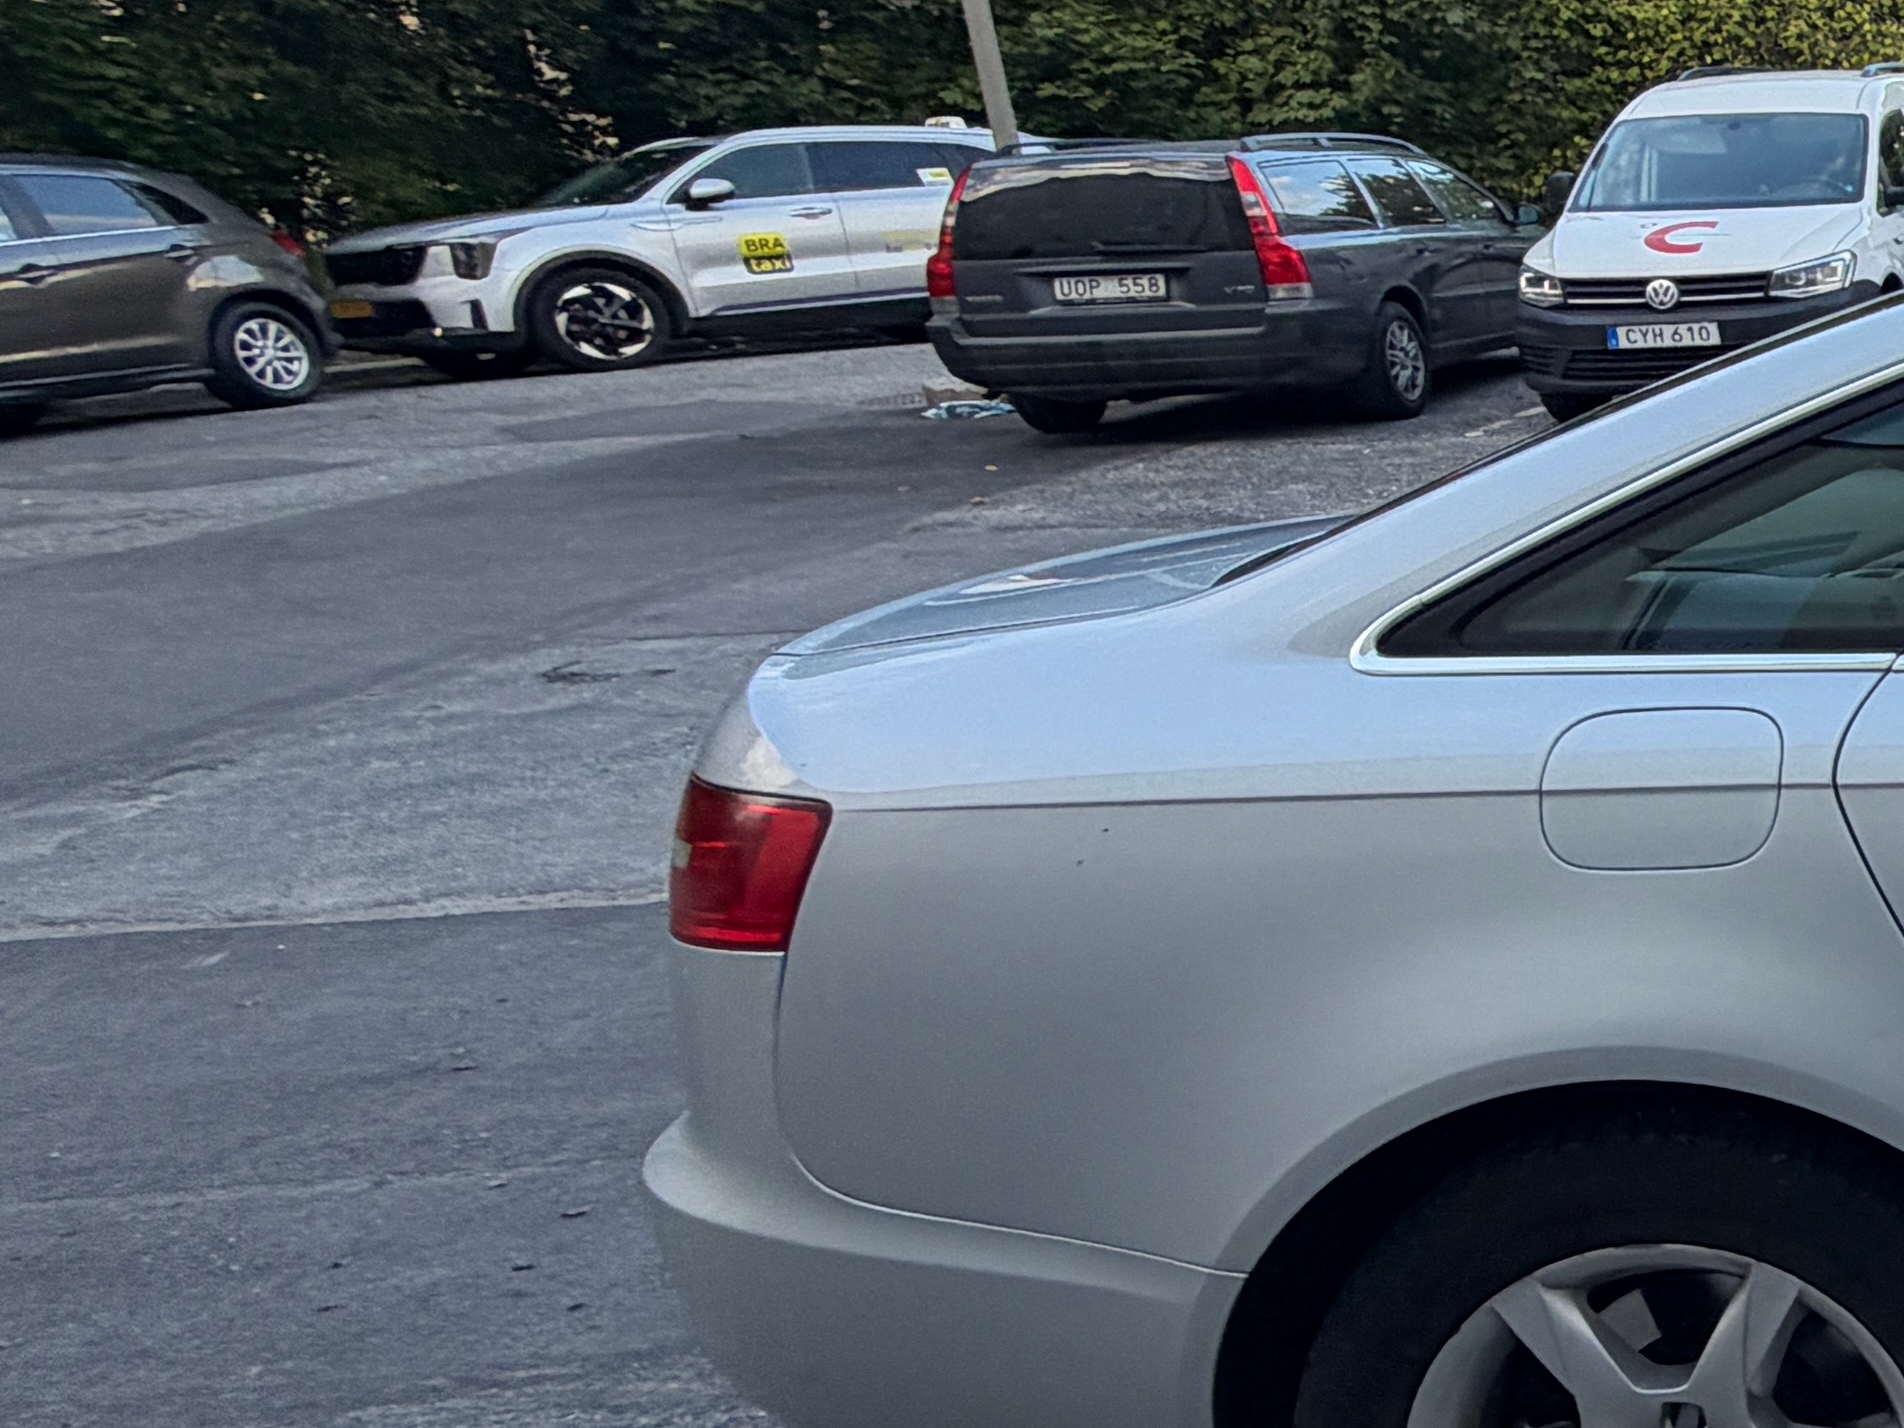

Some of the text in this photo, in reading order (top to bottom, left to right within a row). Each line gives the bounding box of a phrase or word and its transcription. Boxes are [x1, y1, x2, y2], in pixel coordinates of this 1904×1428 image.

[744, 237, 786, 253] BRA
[751, 256, 791, 273] taxi
[1060, 276, 1160, 298] UOP 558
[1625, 325, 1711, 345] CYH 610
